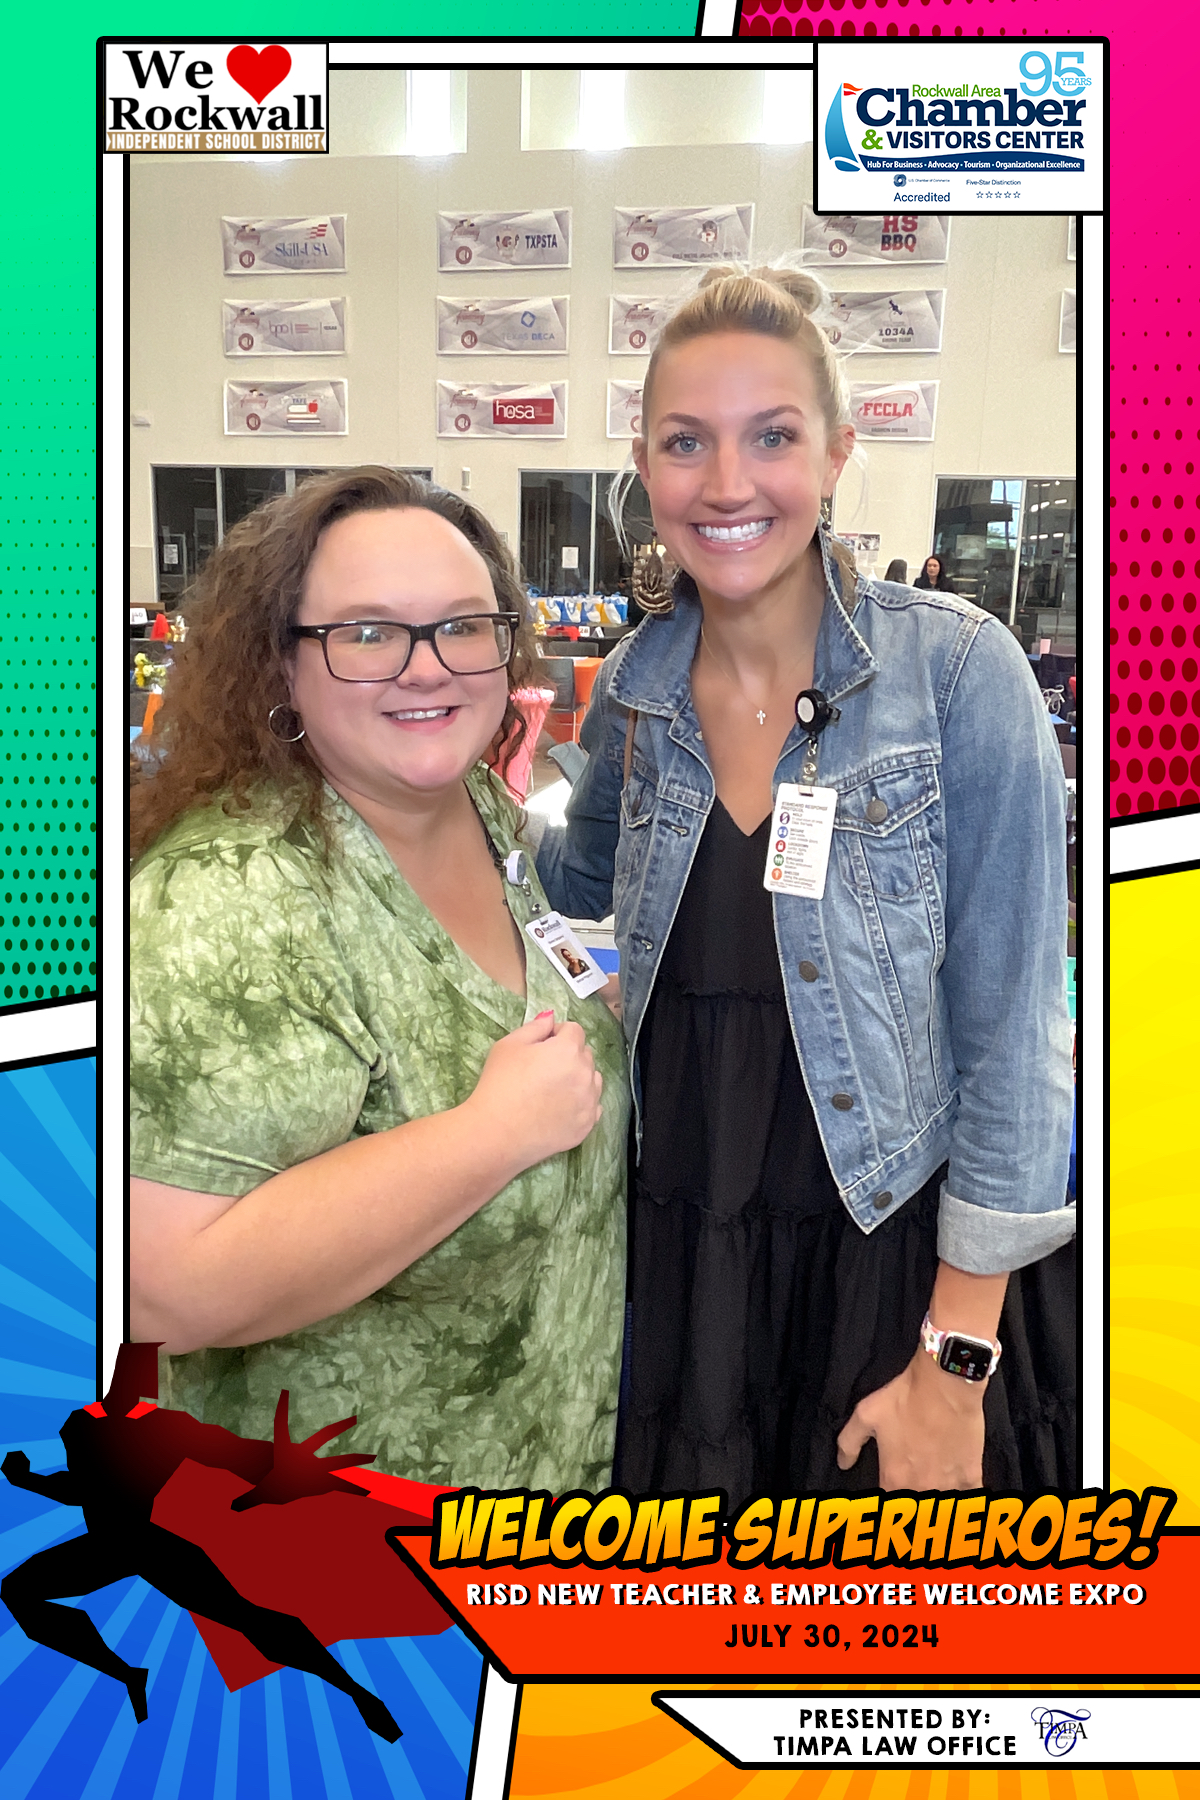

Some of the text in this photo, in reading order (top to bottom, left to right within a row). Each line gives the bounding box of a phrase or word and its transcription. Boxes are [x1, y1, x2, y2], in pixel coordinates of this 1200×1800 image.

[882, 216, 918, 233] HS
[525, 234, 558, 249] TXPSTA
[881, 234, 917, 252] BBQ
[878, 327, 914, 336] 1034A
[496, 400, 535, 419] hosa
[863, 403, 913, 417] FCCLA
